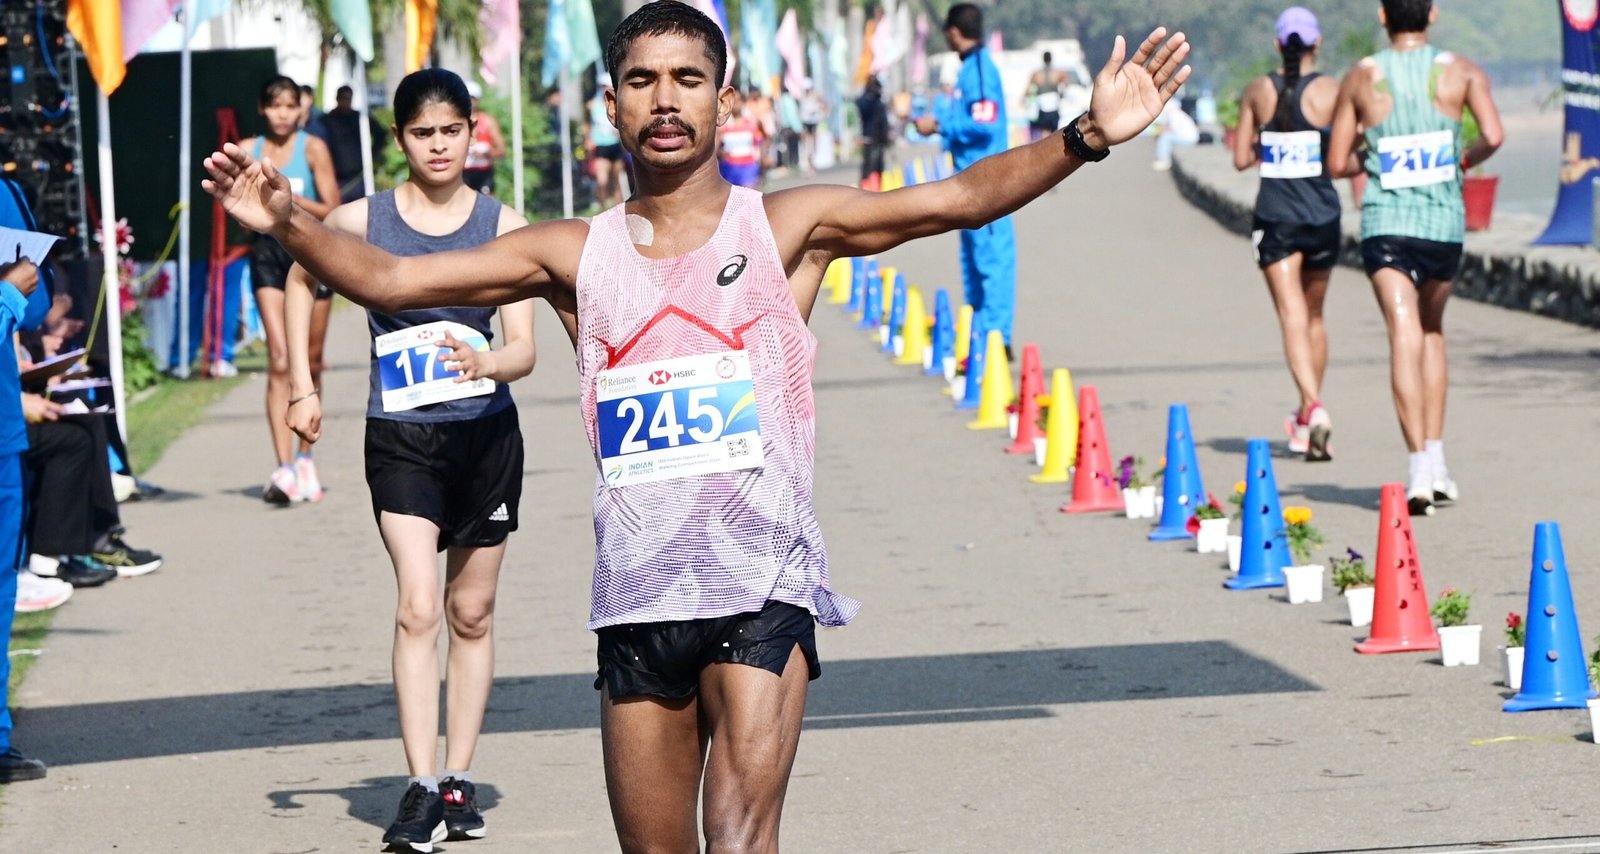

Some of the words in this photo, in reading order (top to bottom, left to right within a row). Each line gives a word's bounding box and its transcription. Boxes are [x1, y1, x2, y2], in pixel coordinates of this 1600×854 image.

[1390, 146, 1441, 174] 217
[395, 342, 465, 387] 17
[673, 369, 697, 379] HSBC
[608, 376, 636, 387] Reliance
[616, 387, 724, 455] 245
[628, 461, 654, 471] INDIAN
